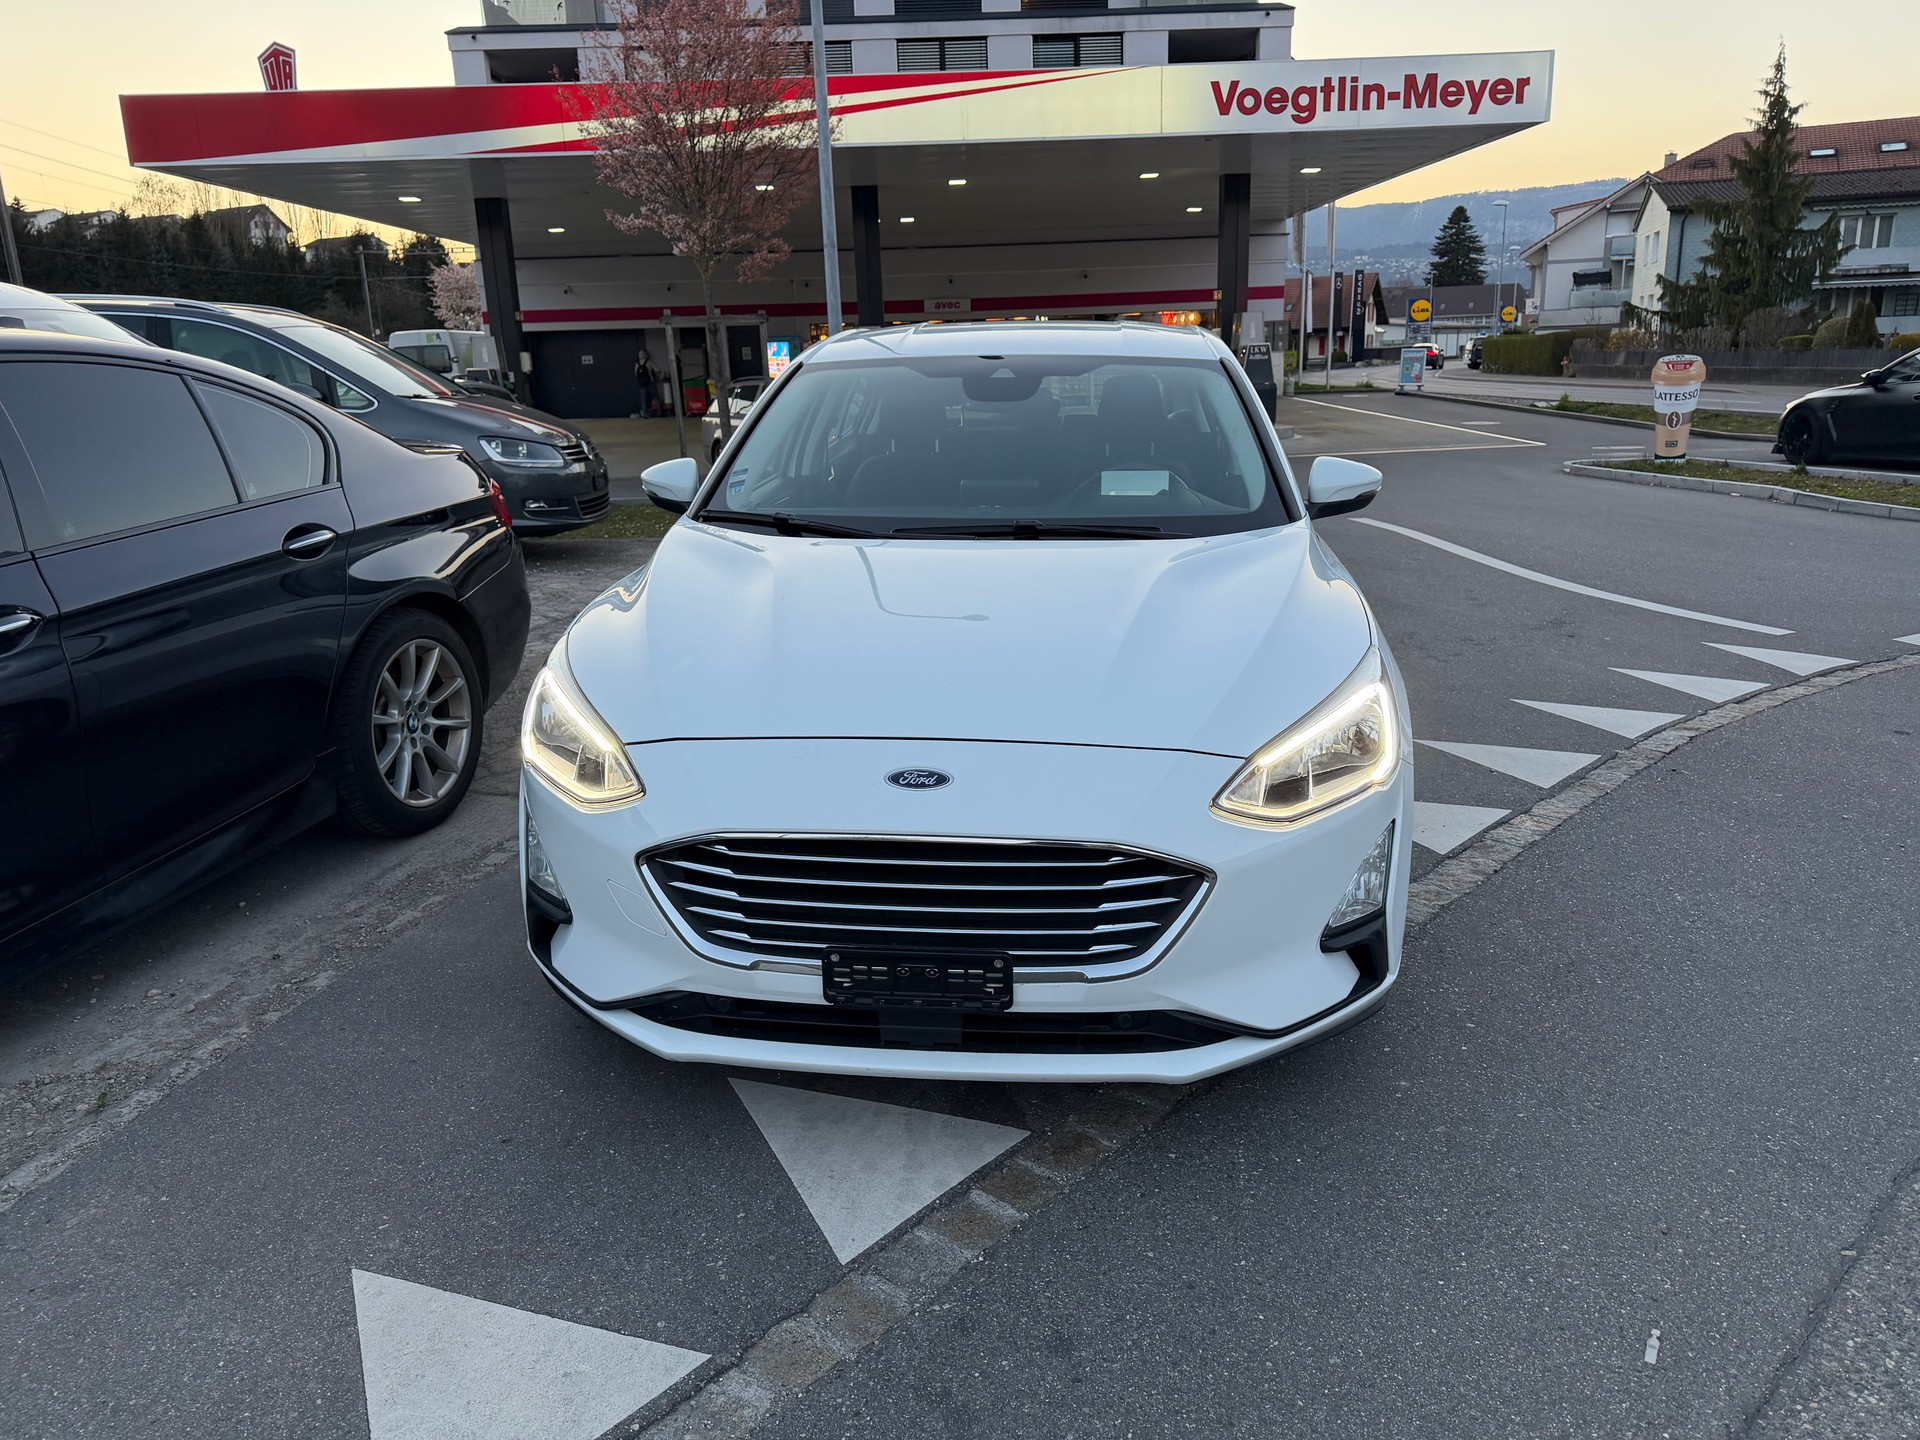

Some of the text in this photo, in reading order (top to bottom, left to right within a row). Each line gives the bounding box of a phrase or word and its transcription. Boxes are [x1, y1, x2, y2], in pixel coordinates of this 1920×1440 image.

[261, 47, 294, 91] UTA
[1210, 72, 1531, 125] Voegtlin-Meyer
[934, 301, 961, 310] avec
[1250, 345, 1268, 354] LKW
[1654, 388, 1699, 402] LATTESSO
[899, 771, 938, 785] Ford
